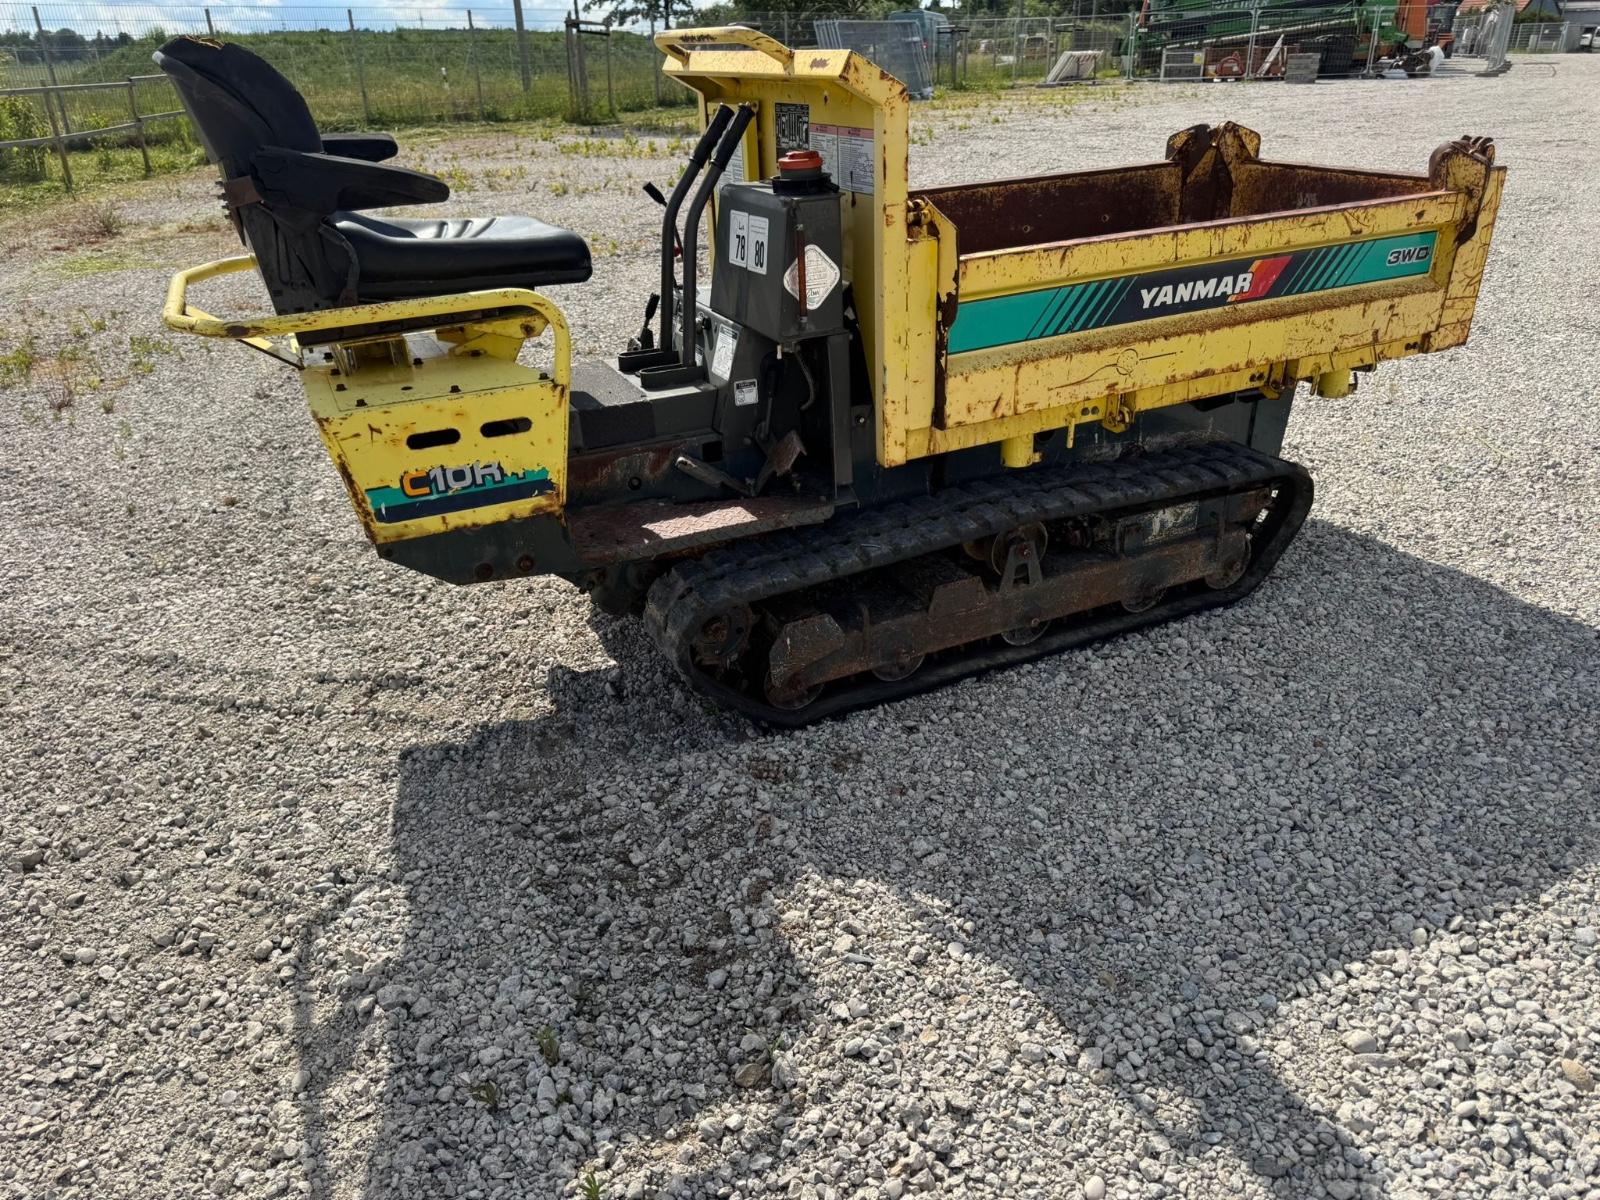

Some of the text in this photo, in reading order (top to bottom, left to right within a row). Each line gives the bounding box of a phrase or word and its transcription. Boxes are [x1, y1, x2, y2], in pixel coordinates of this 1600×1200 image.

[736, 234, 746, 261] 78
[755, 240, 765, 268] 80
[1387, 246, 1430, 266] 3WD
[1140, 272, 1253, 309] YANMAR
[403, 460, 525, 496] C10R
